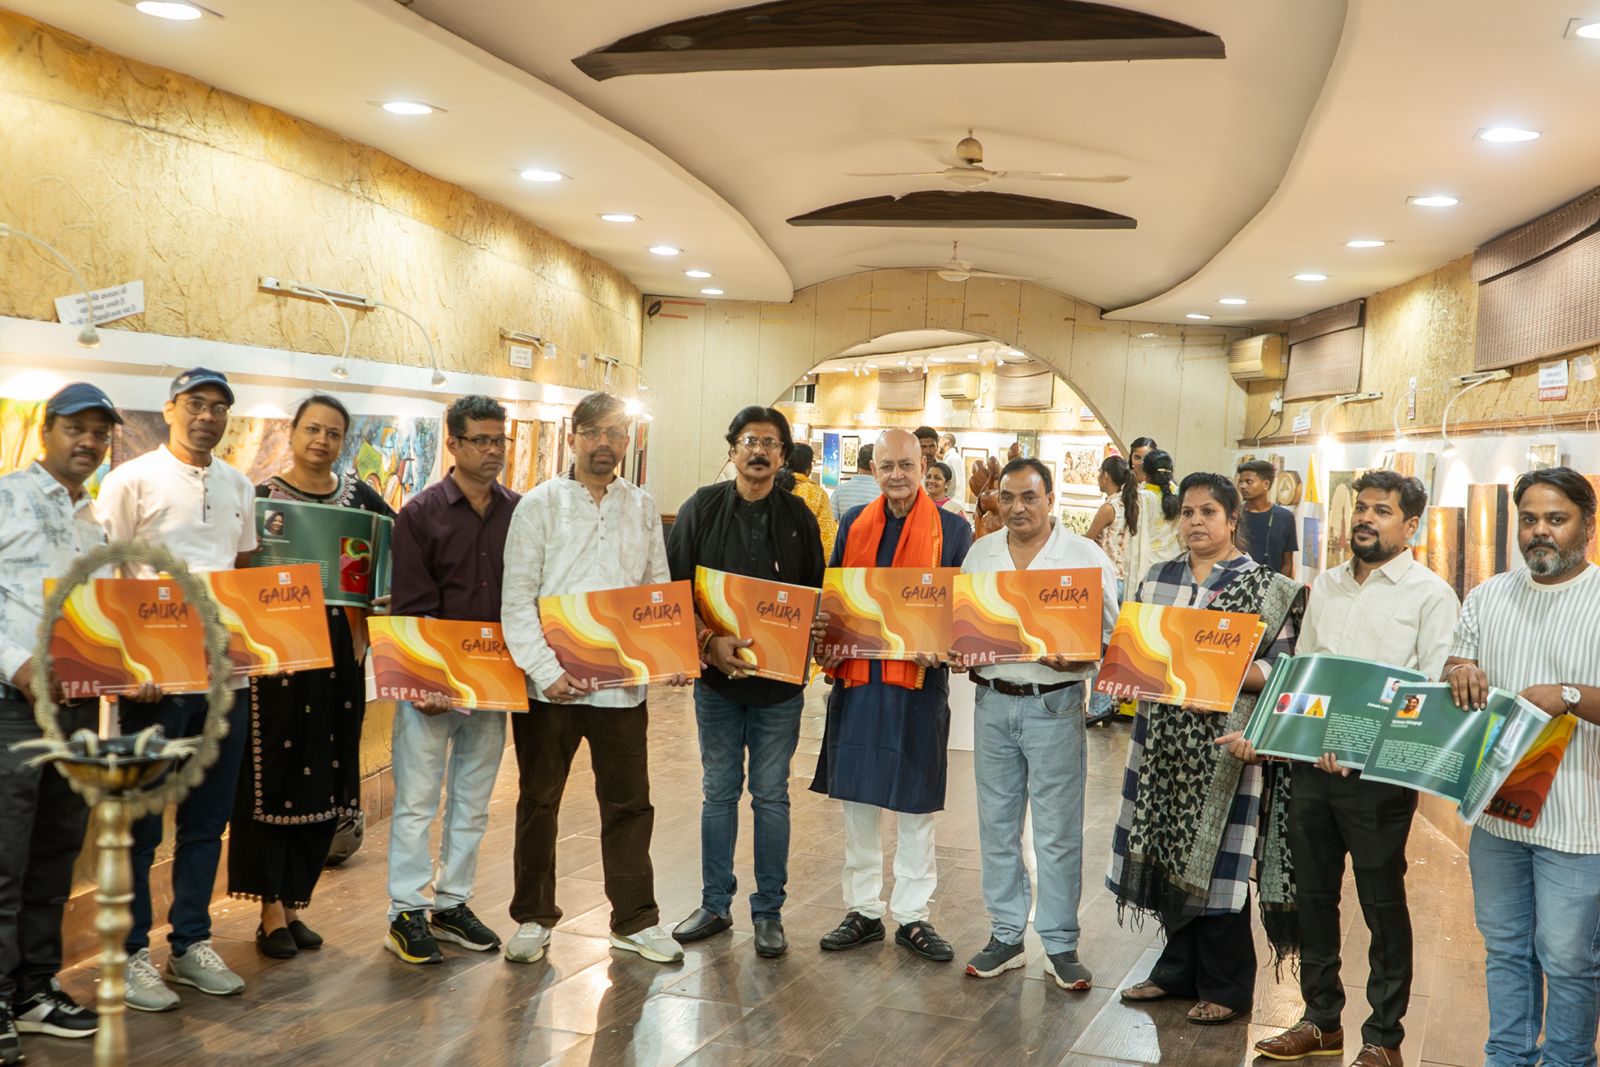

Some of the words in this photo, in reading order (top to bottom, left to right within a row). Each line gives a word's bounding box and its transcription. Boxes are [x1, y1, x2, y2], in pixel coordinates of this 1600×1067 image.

[258, 585, 312, 606] GAURA
[901, 585, 947, 602] GAURA
[1039, 587, 1089, 604] GAURA
[138, 602, 188, 621] GAURA
[632, 602, 682, 623] GAURA
[757, 600, 801, 624] GAURA
[1194, 629, 1241, 649] GAURA
[61, 680, 100, 699] GPAG
